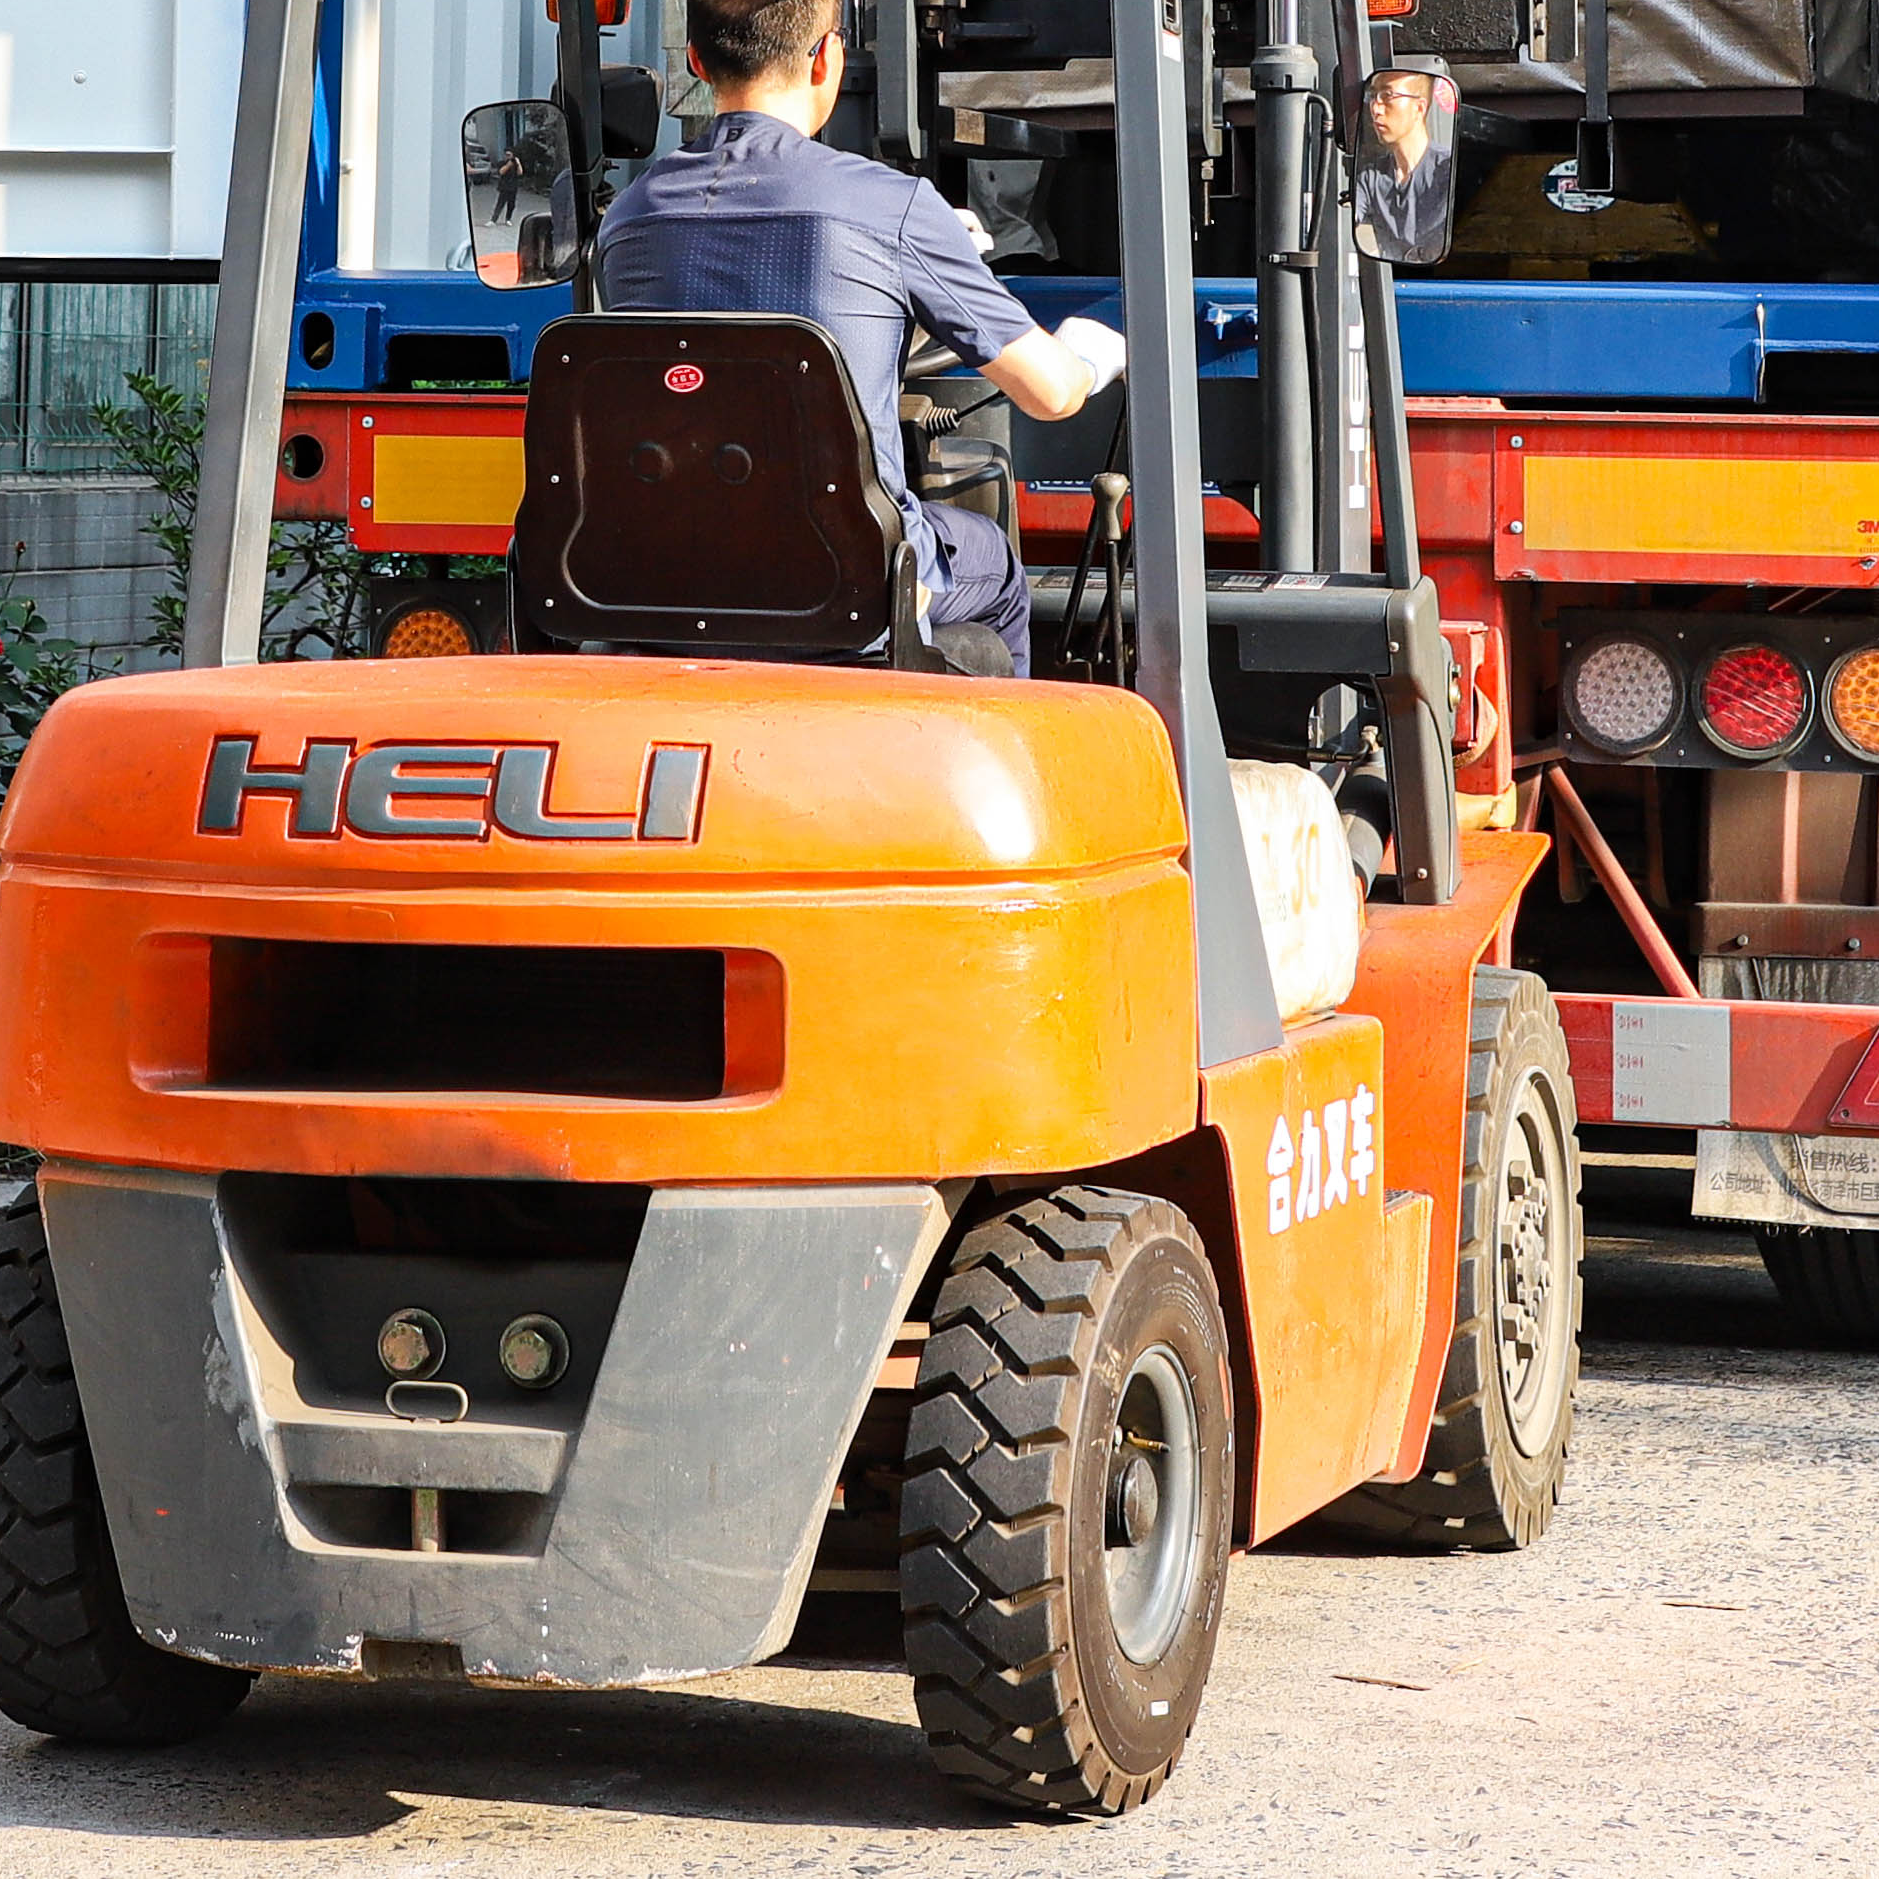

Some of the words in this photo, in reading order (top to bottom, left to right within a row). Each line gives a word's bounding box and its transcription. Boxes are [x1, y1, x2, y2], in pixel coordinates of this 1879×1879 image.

[197, 733, 710, 844] HELI
[1267, 1083, 1376, 1235] 合力叉车
